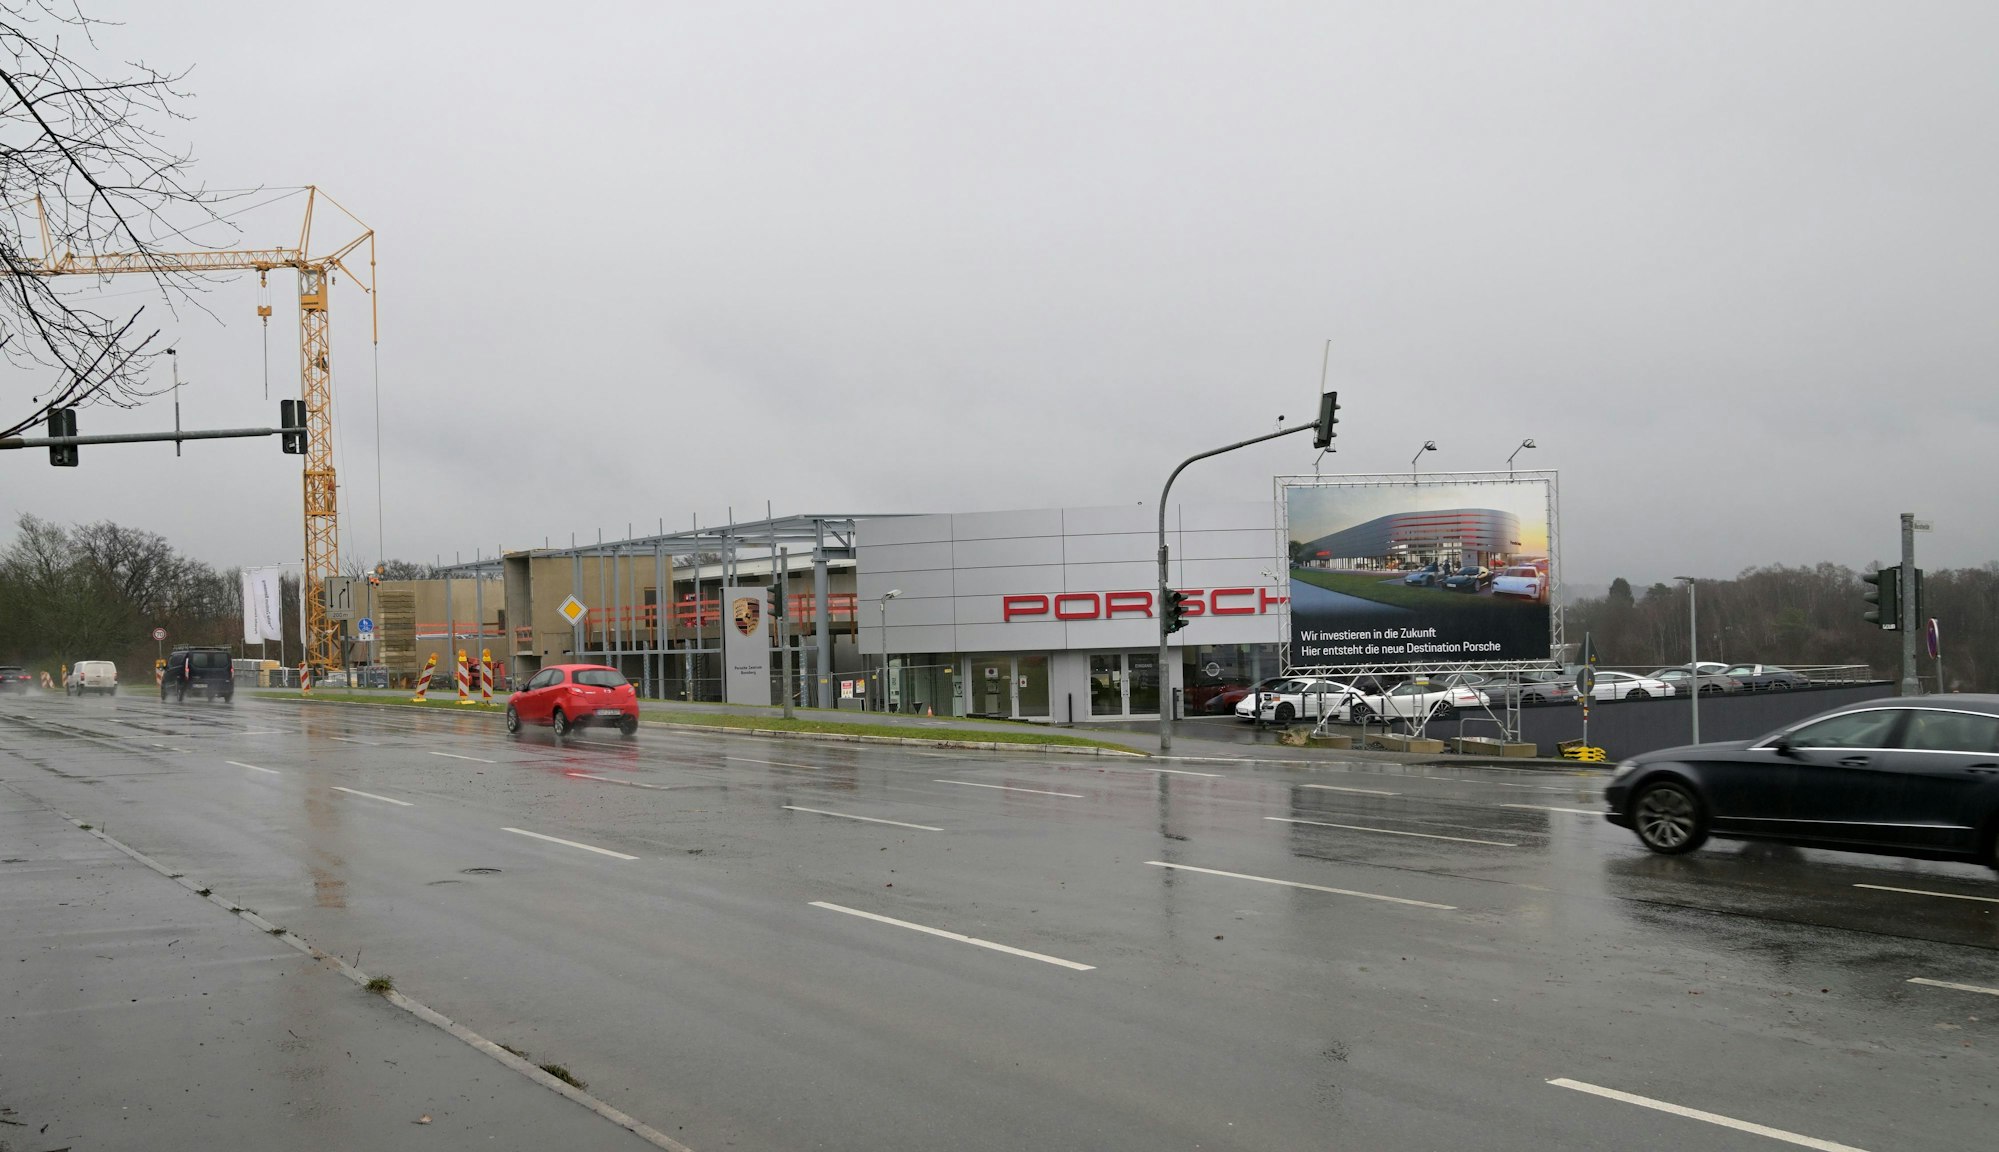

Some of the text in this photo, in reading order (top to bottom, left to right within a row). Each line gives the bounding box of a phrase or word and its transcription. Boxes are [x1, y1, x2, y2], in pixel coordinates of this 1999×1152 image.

[1300, 626, 1436, 641] Wir investieren in die Zukunft
[1301, 640, 1501, 657] Hier entsteht die neue Destination Porsche
